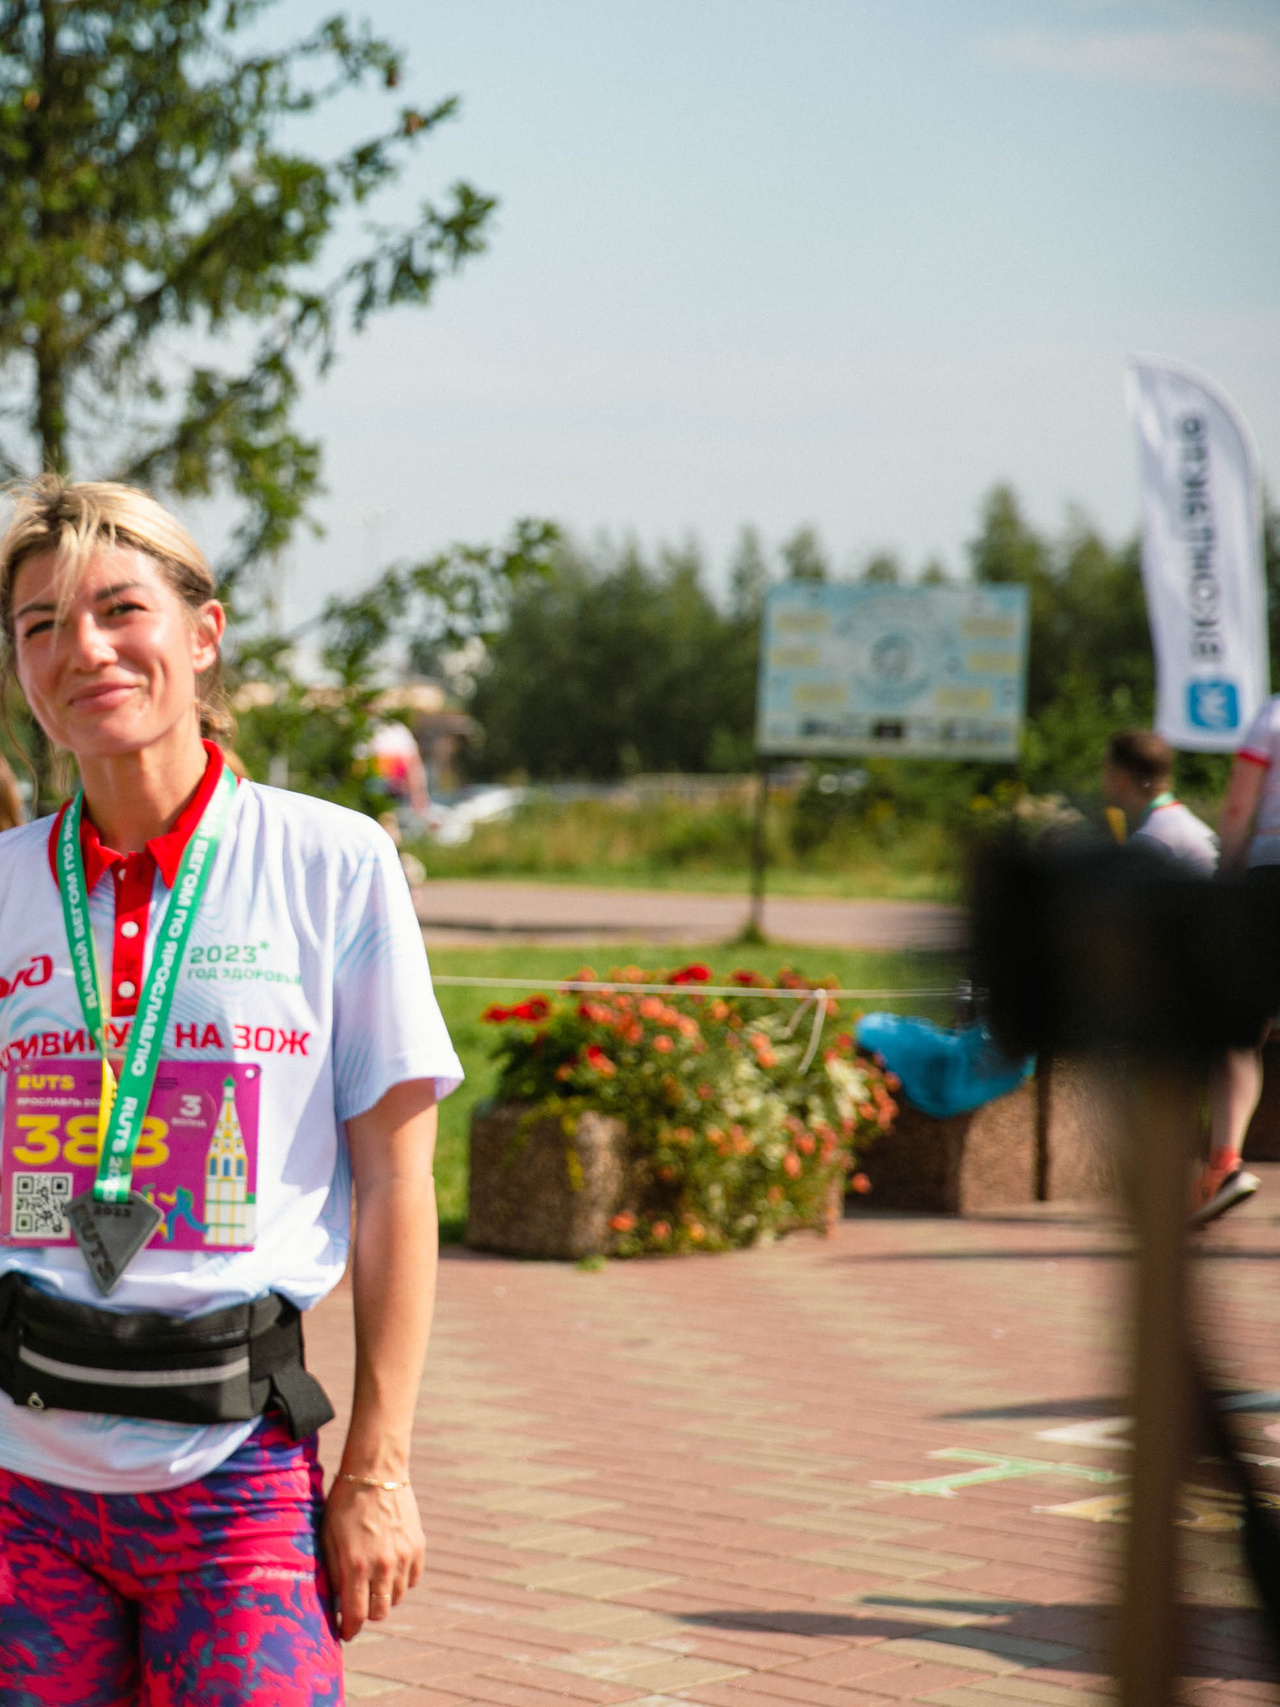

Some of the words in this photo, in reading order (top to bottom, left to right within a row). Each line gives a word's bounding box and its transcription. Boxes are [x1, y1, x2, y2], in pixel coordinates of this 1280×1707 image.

[63, 843, 76, 871] ПО
[177, 839, 209, 907] БЕГОМ
[66, 872, 86, 939] БЕГОМ
[168, 908, 189, 939] ПО
[190, 945, 258, 964] 2023
[74, 940, 98, 1010] ДАВАЙ
[187, 967, 219, 981] ГОД
[130, 941, 178, 1077] ЯРОСЛАВЛЮ
[175, 1022, 225, 1049] НА
[231, 1024, 312, 1057] ЗОЖ
[16, 1073, 75, 1092] RUTS
[16, 1096, 82, 1108] ЯРОСЛАВЛЬ
[83, 1097, 101, 1109] 202
[180, 1094, 203, 1118] 3
[12, 1113, 171, 1168] 388
[112, 1096, 139, 1154] RUTS
[102, 1155, 123, 1202] 20
